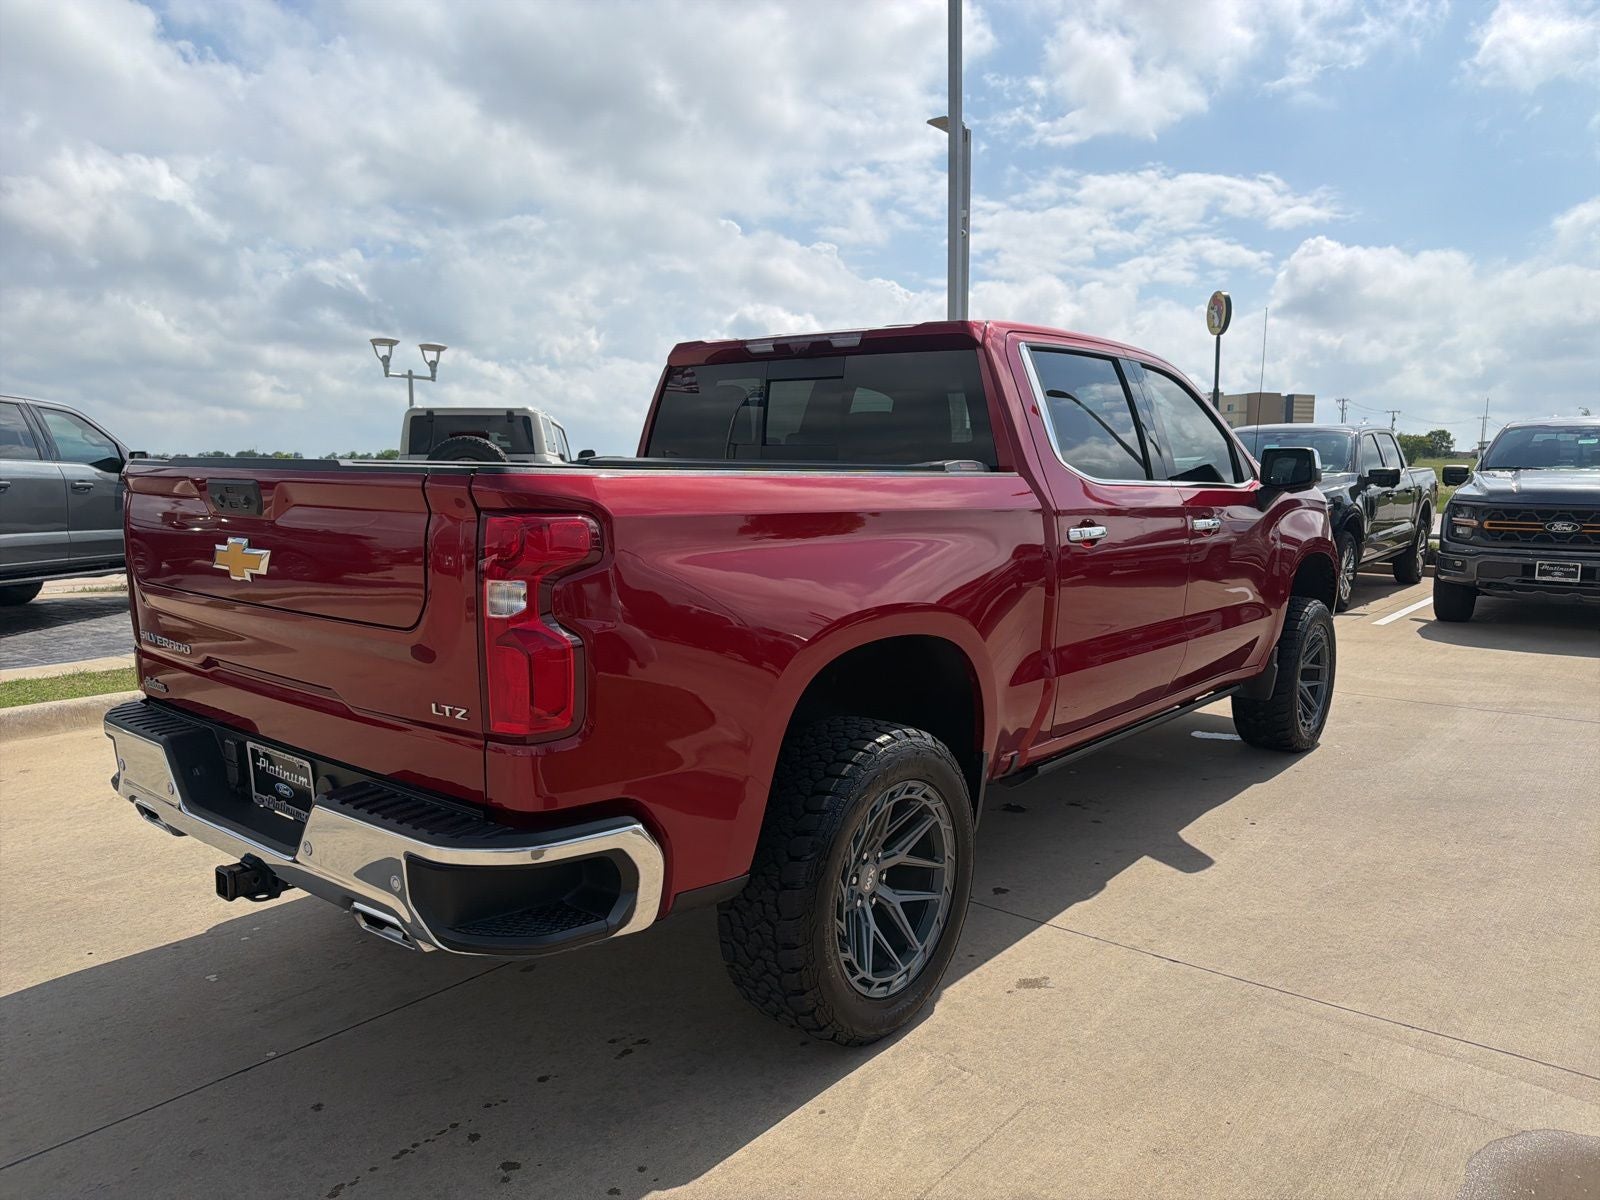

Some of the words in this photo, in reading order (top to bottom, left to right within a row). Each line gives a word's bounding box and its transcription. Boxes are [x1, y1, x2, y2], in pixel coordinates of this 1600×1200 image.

[1550, 522, 1574, 532] Ford
[140, 630, 191, 654] SILVERADO
[431, 702, 468, 721] LTZ
[256, 757, 311, 788] Platinum
[267, 796, 305, 820] Platinum
